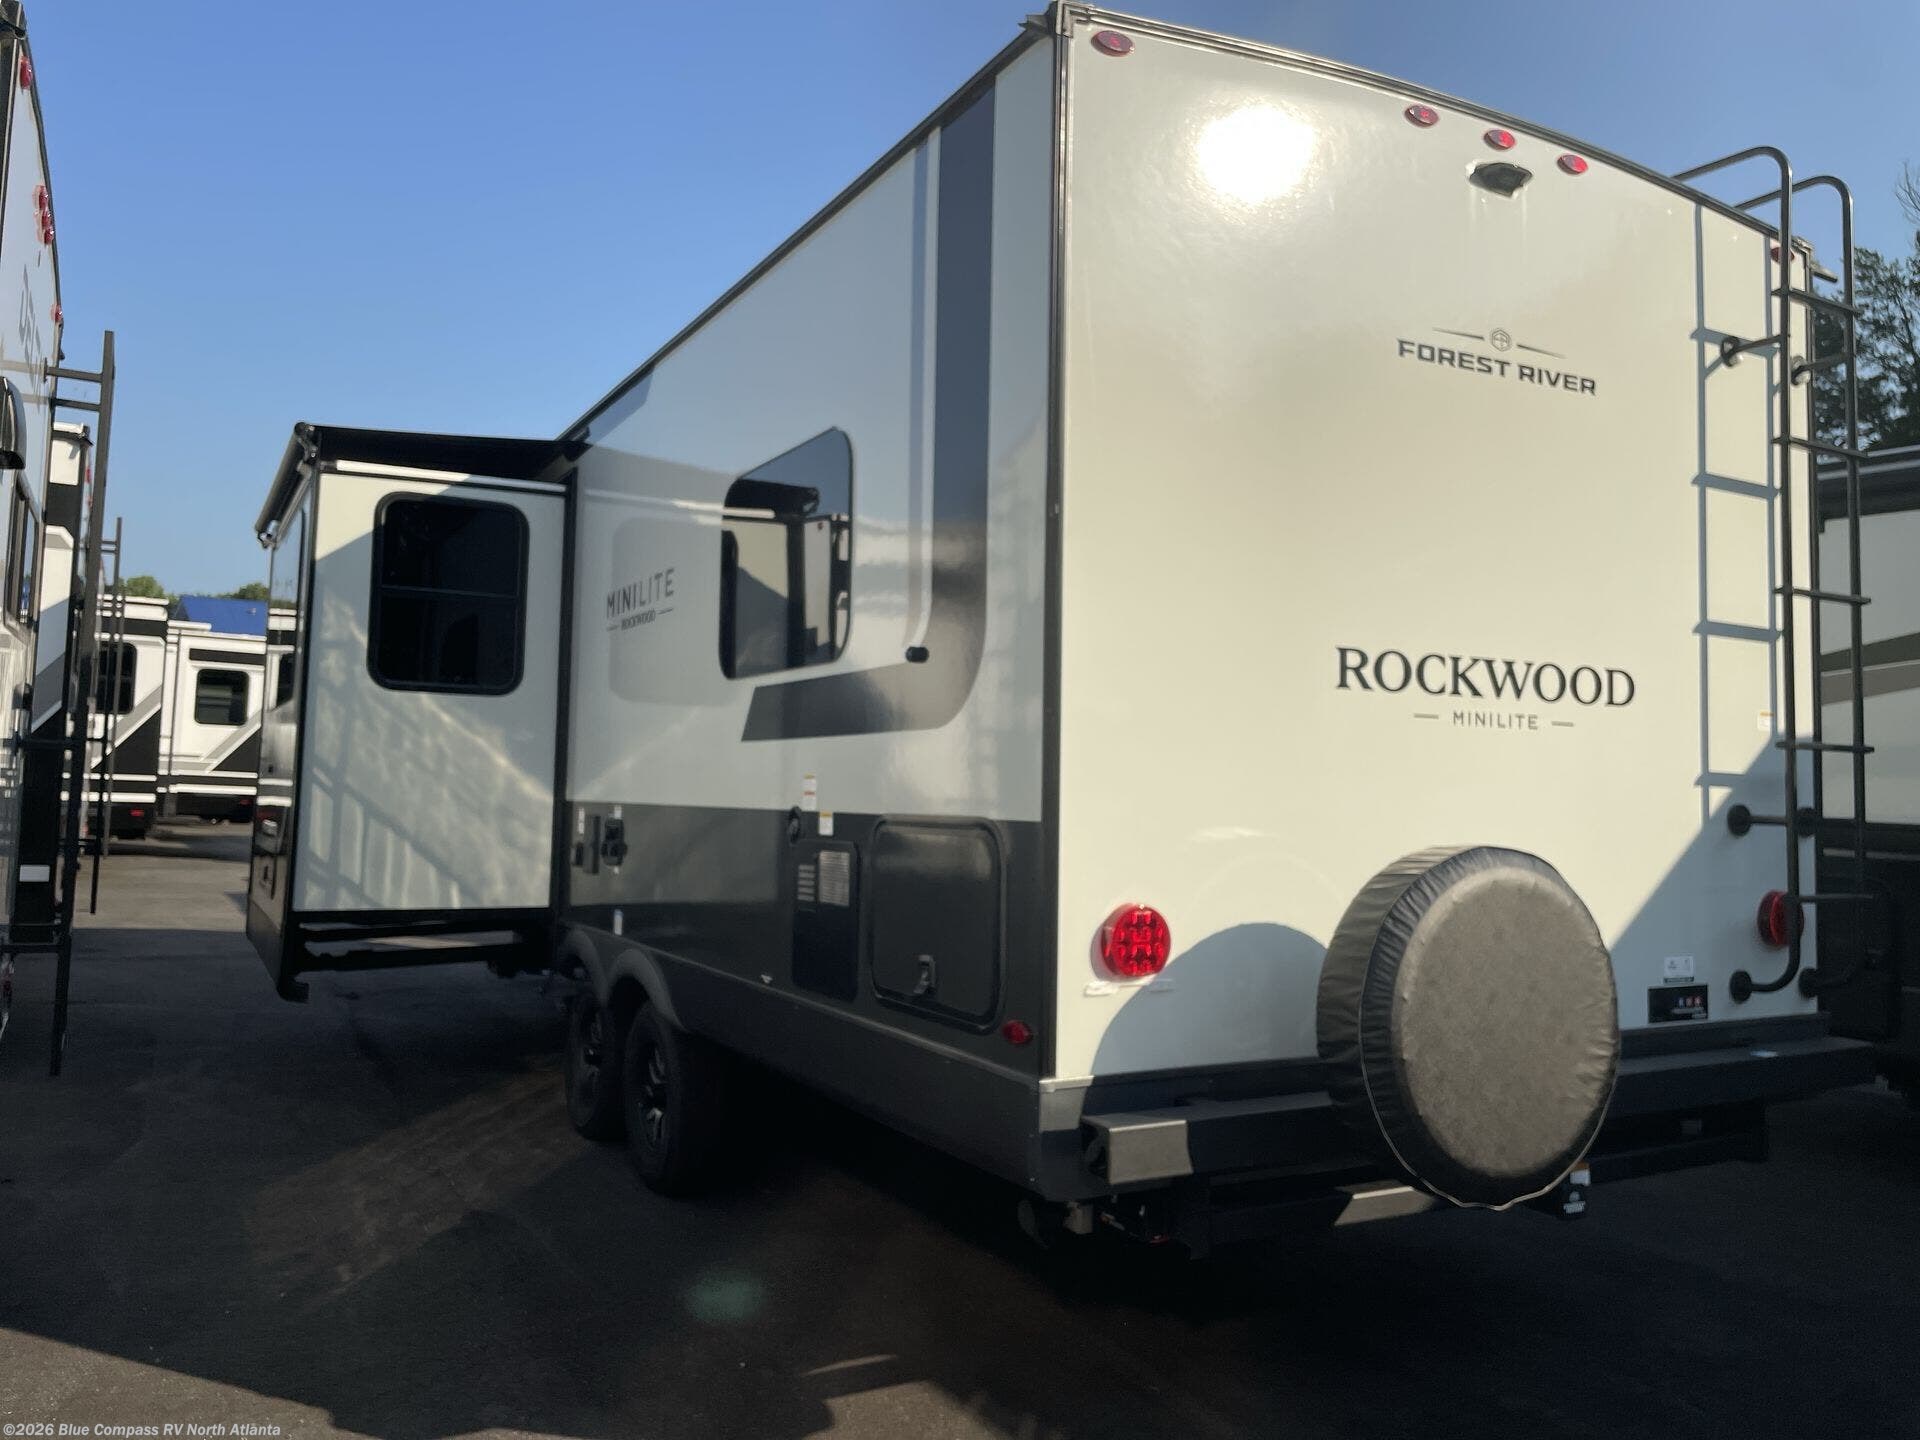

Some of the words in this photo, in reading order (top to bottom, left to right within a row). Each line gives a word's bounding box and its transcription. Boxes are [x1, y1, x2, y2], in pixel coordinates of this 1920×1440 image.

[1397, 338, 1511, 377] FOREST
[1517, 364, 1597, 396] RIVER
[606, 568, 675, 619] MINILITE
[1336, 646, 1635, 706] ROCKWOOD
[1452, 711, 1539, 730] MINILITE
